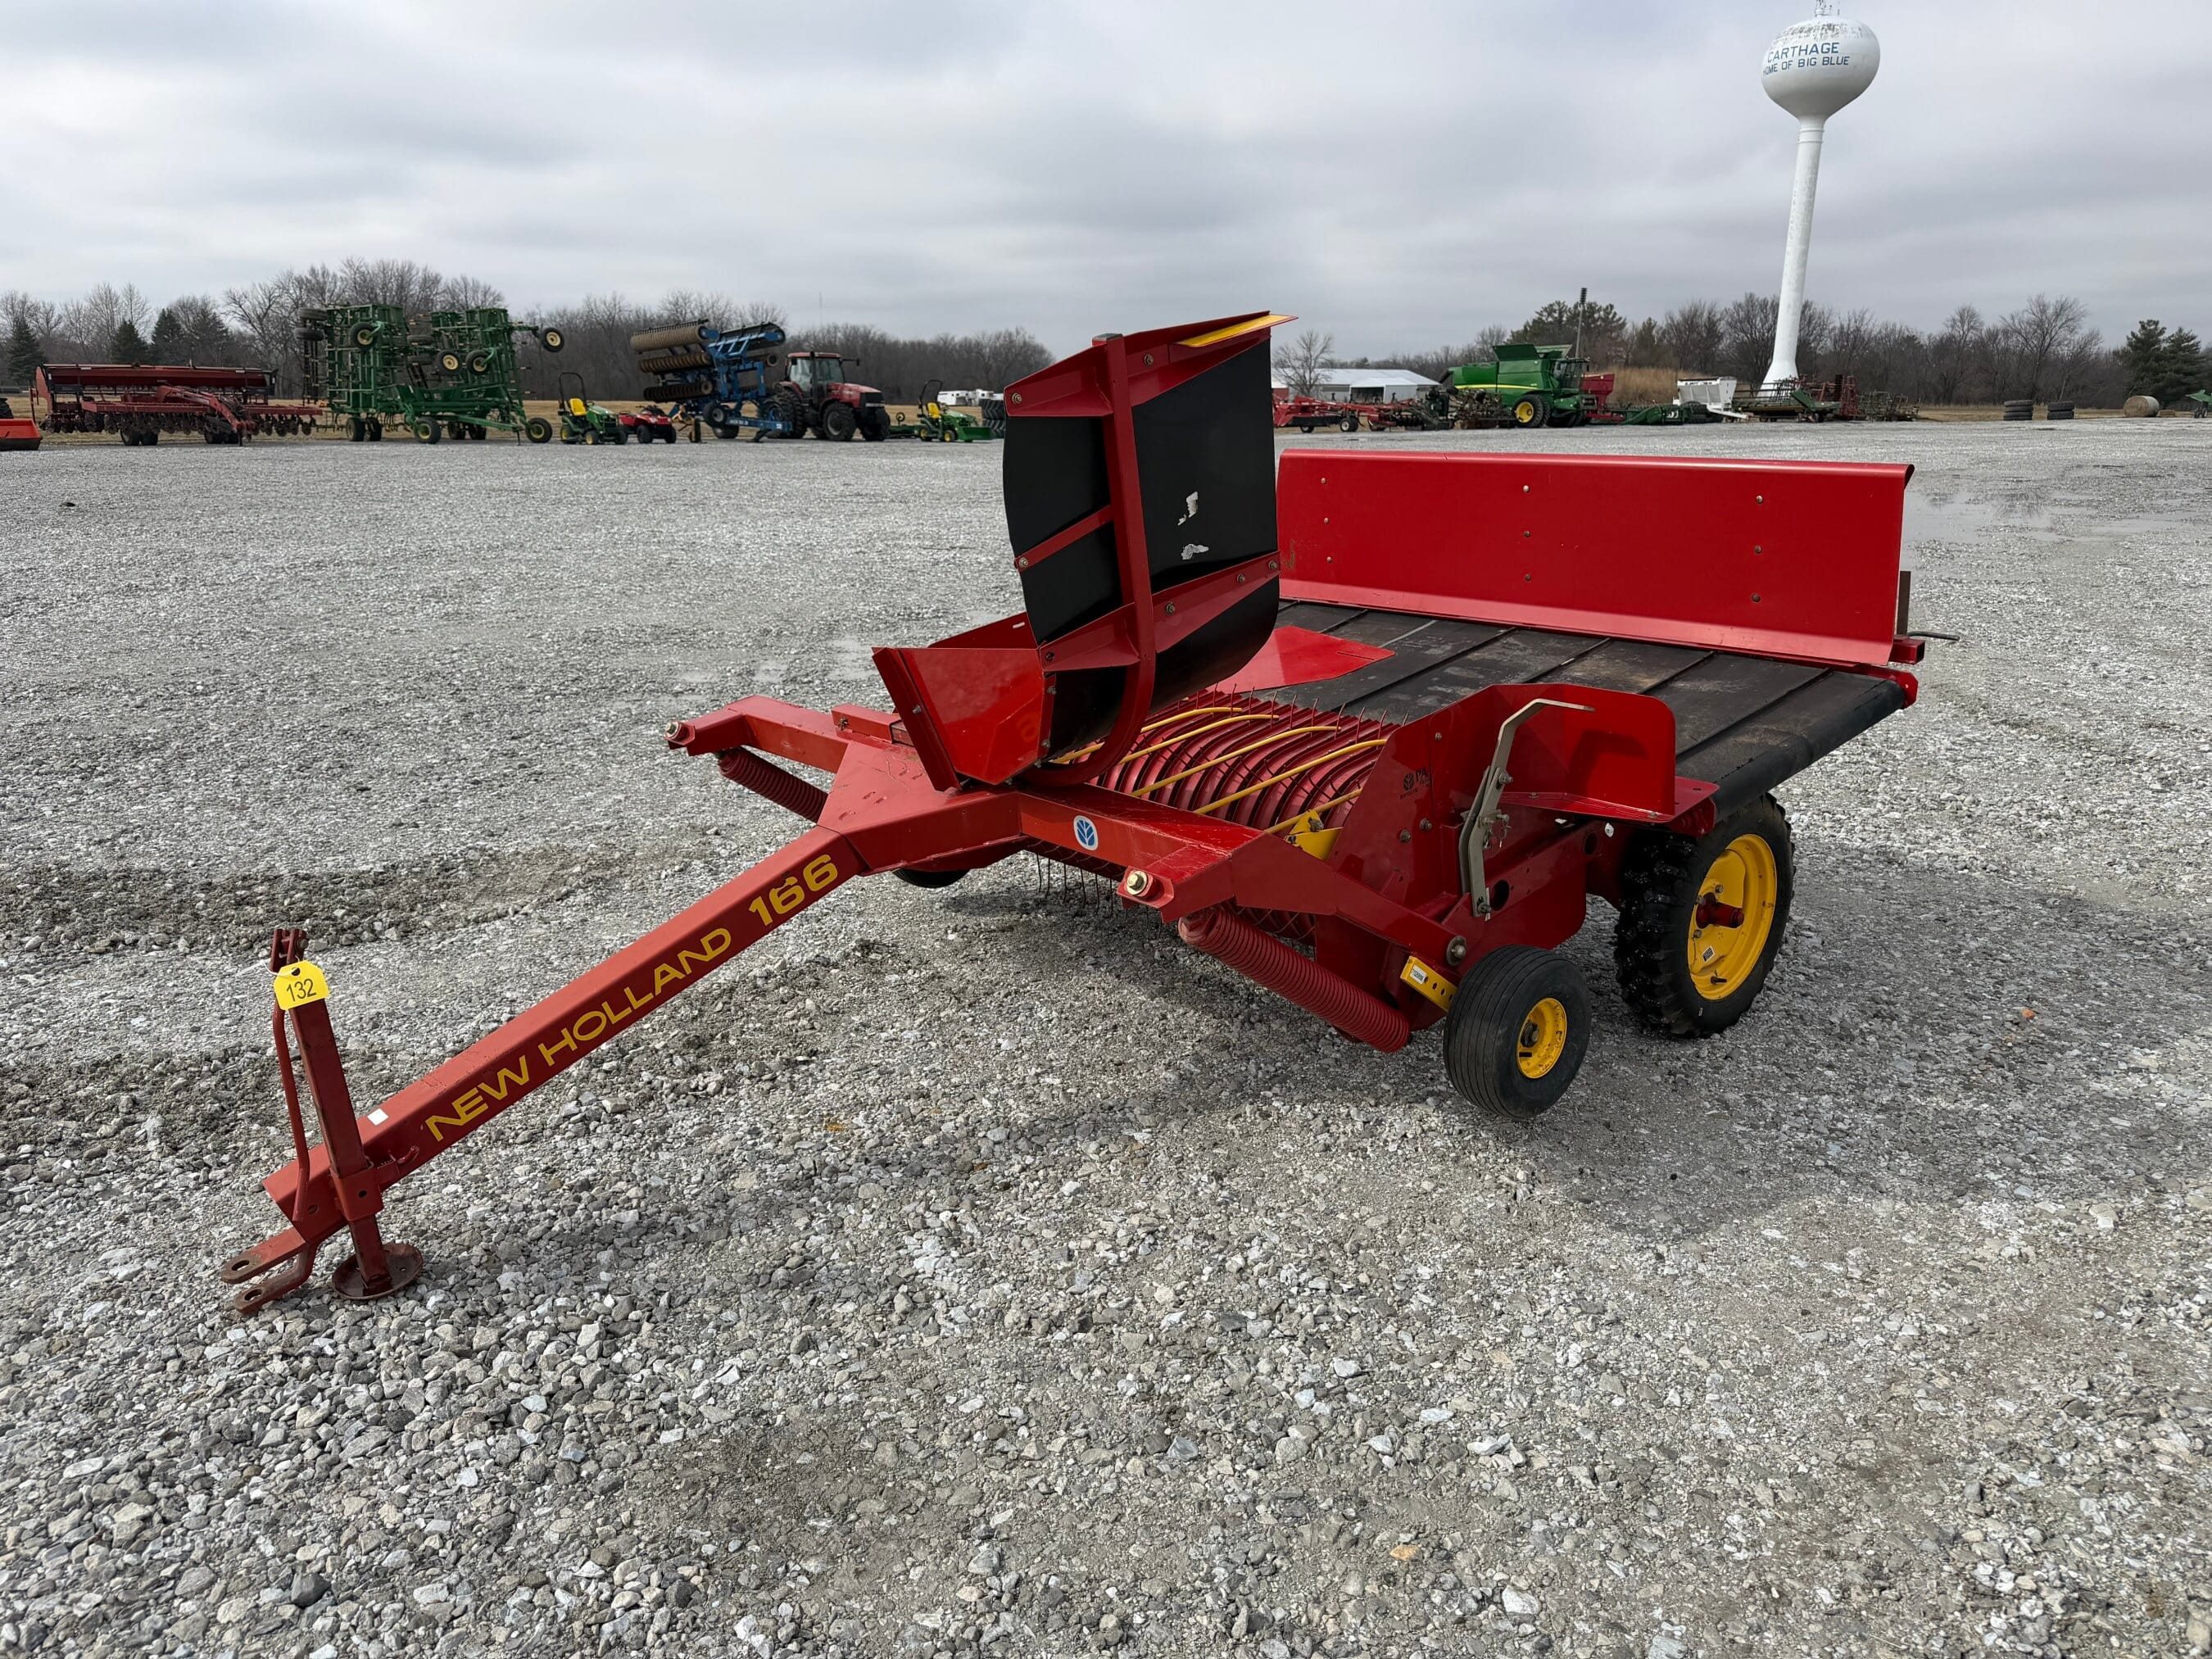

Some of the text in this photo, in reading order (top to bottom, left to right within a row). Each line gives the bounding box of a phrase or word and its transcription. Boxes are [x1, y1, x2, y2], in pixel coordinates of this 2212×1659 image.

[1767, 42, 1840, 63] CARTHAGE
[1781, 60, 1793, 70] OF
[1797, 57, 1817, 68] BIG
[1821, 55, 1850, 66] BLUE
[286, 978, 317, 1002] 132
[424, 854, 838, 1143] NEW HOLLAND 166
